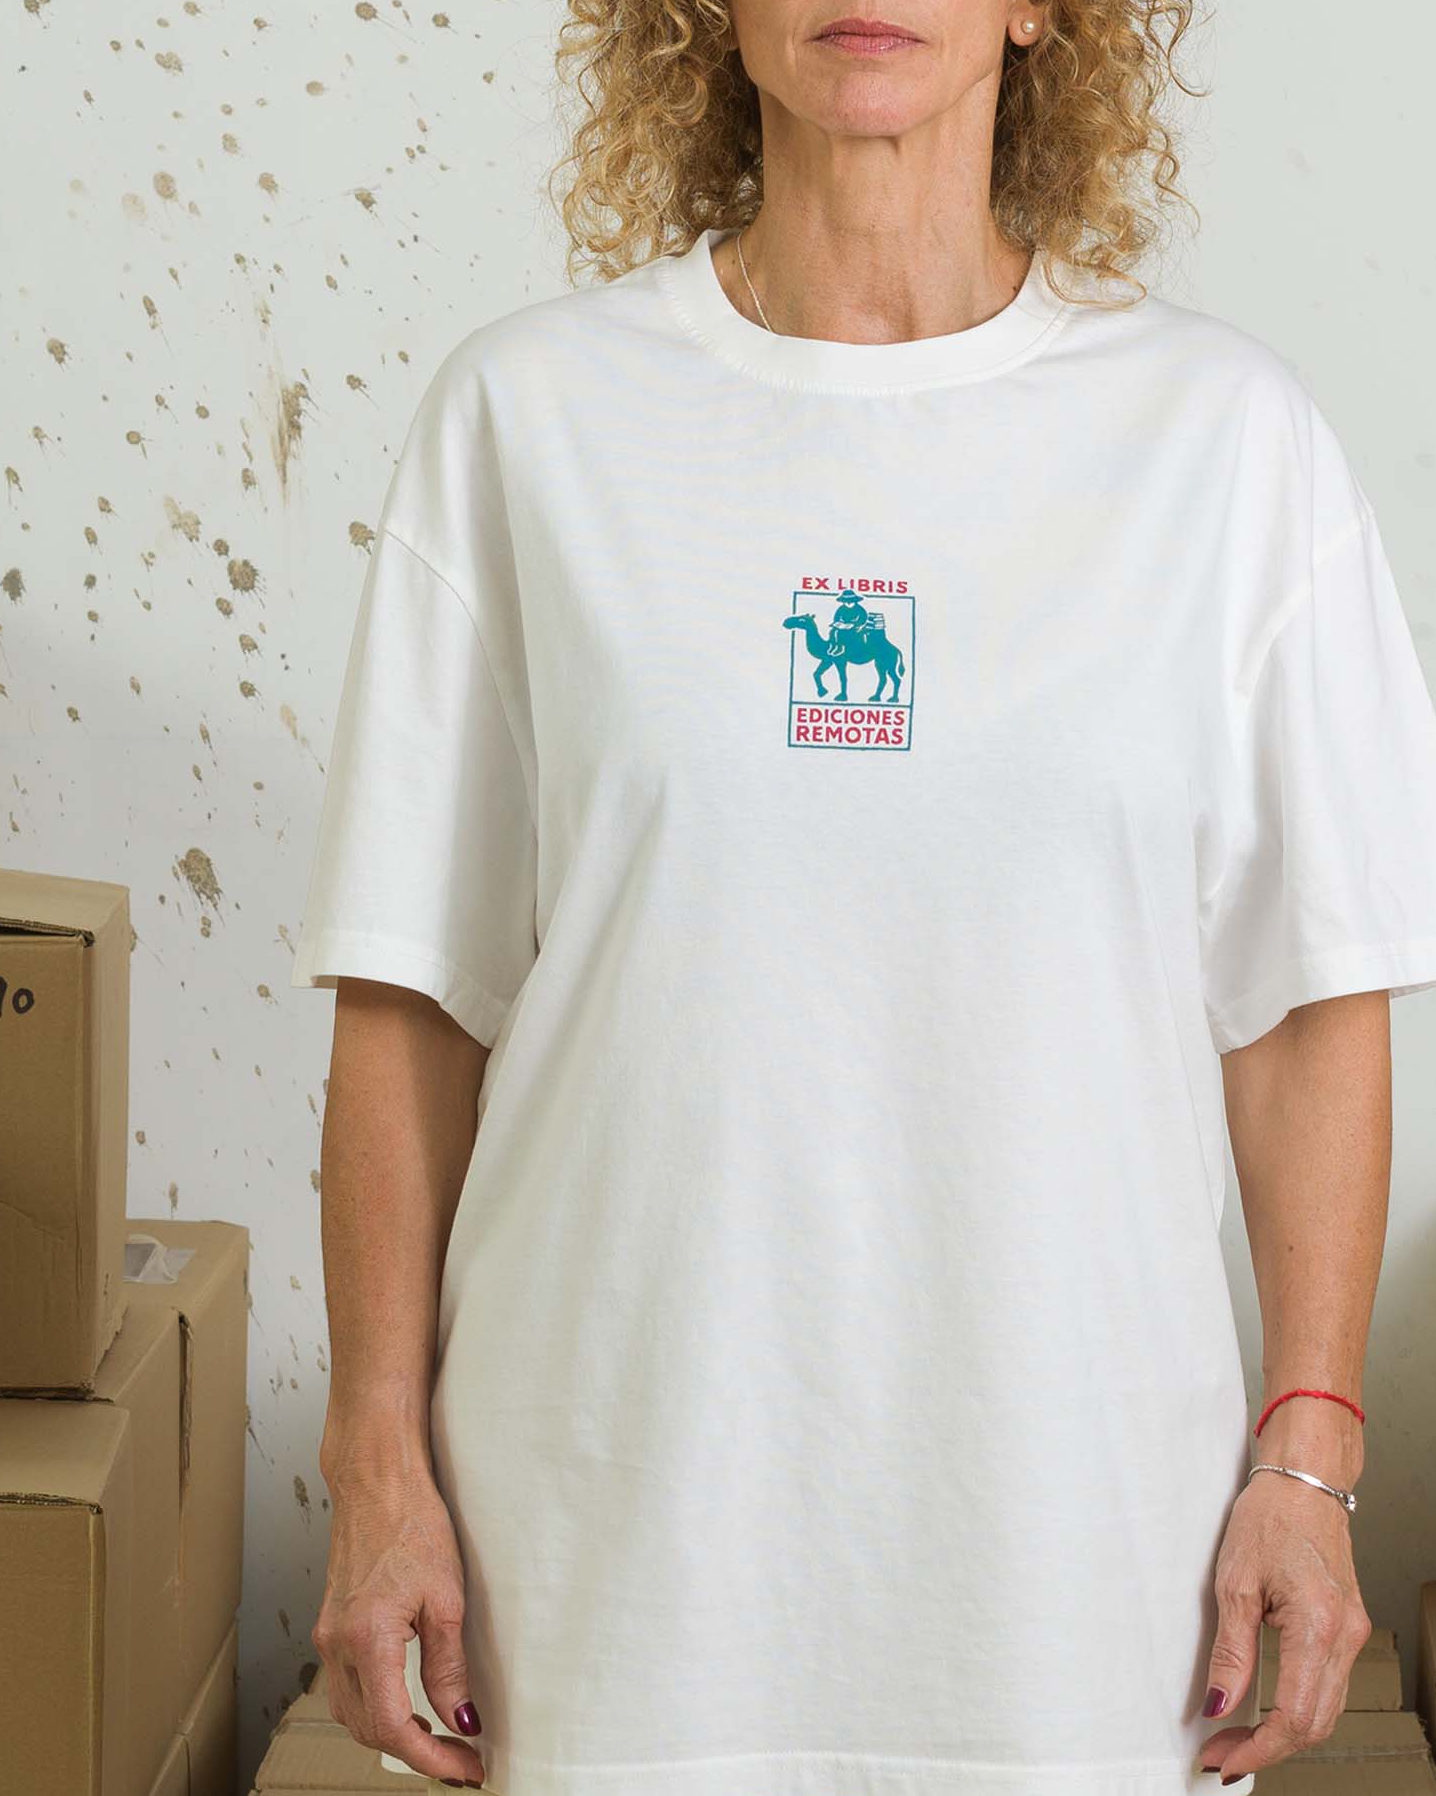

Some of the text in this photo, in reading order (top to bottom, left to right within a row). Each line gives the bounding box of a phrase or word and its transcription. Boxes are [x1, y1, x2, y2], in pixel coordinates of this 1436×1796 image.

[802, 577, 909, 594] EX LIBRIS
[796, 707, 905, 725] EDICIONES
[796, 725, 904, 745] REMOTAS
